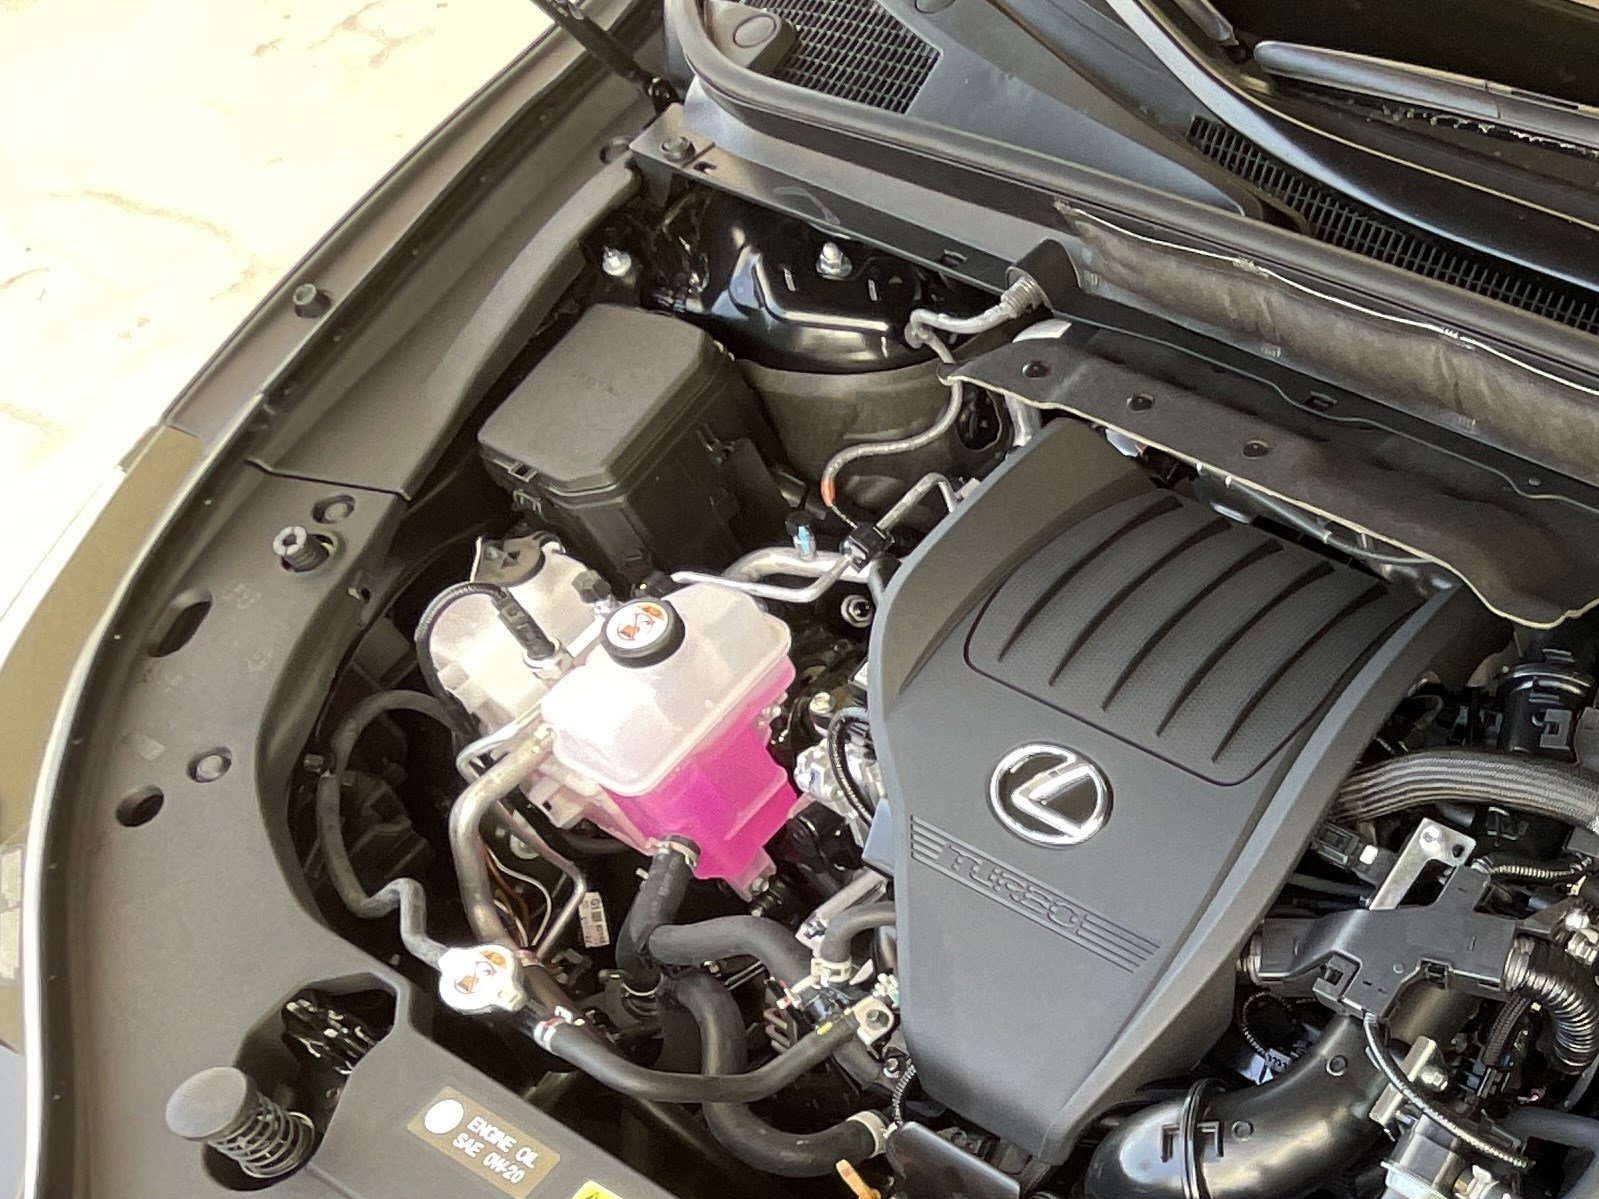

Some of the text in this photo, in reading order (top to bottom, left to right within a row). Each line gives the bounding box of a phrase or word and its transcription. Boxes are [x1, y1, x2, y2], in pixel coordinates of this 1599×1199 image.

[948, 844, 1080, 929] TURBO
[452, 1132, 526, 1184] SAE 0W-20
[466, 1116, 539, 1169] ENGINE OIL
